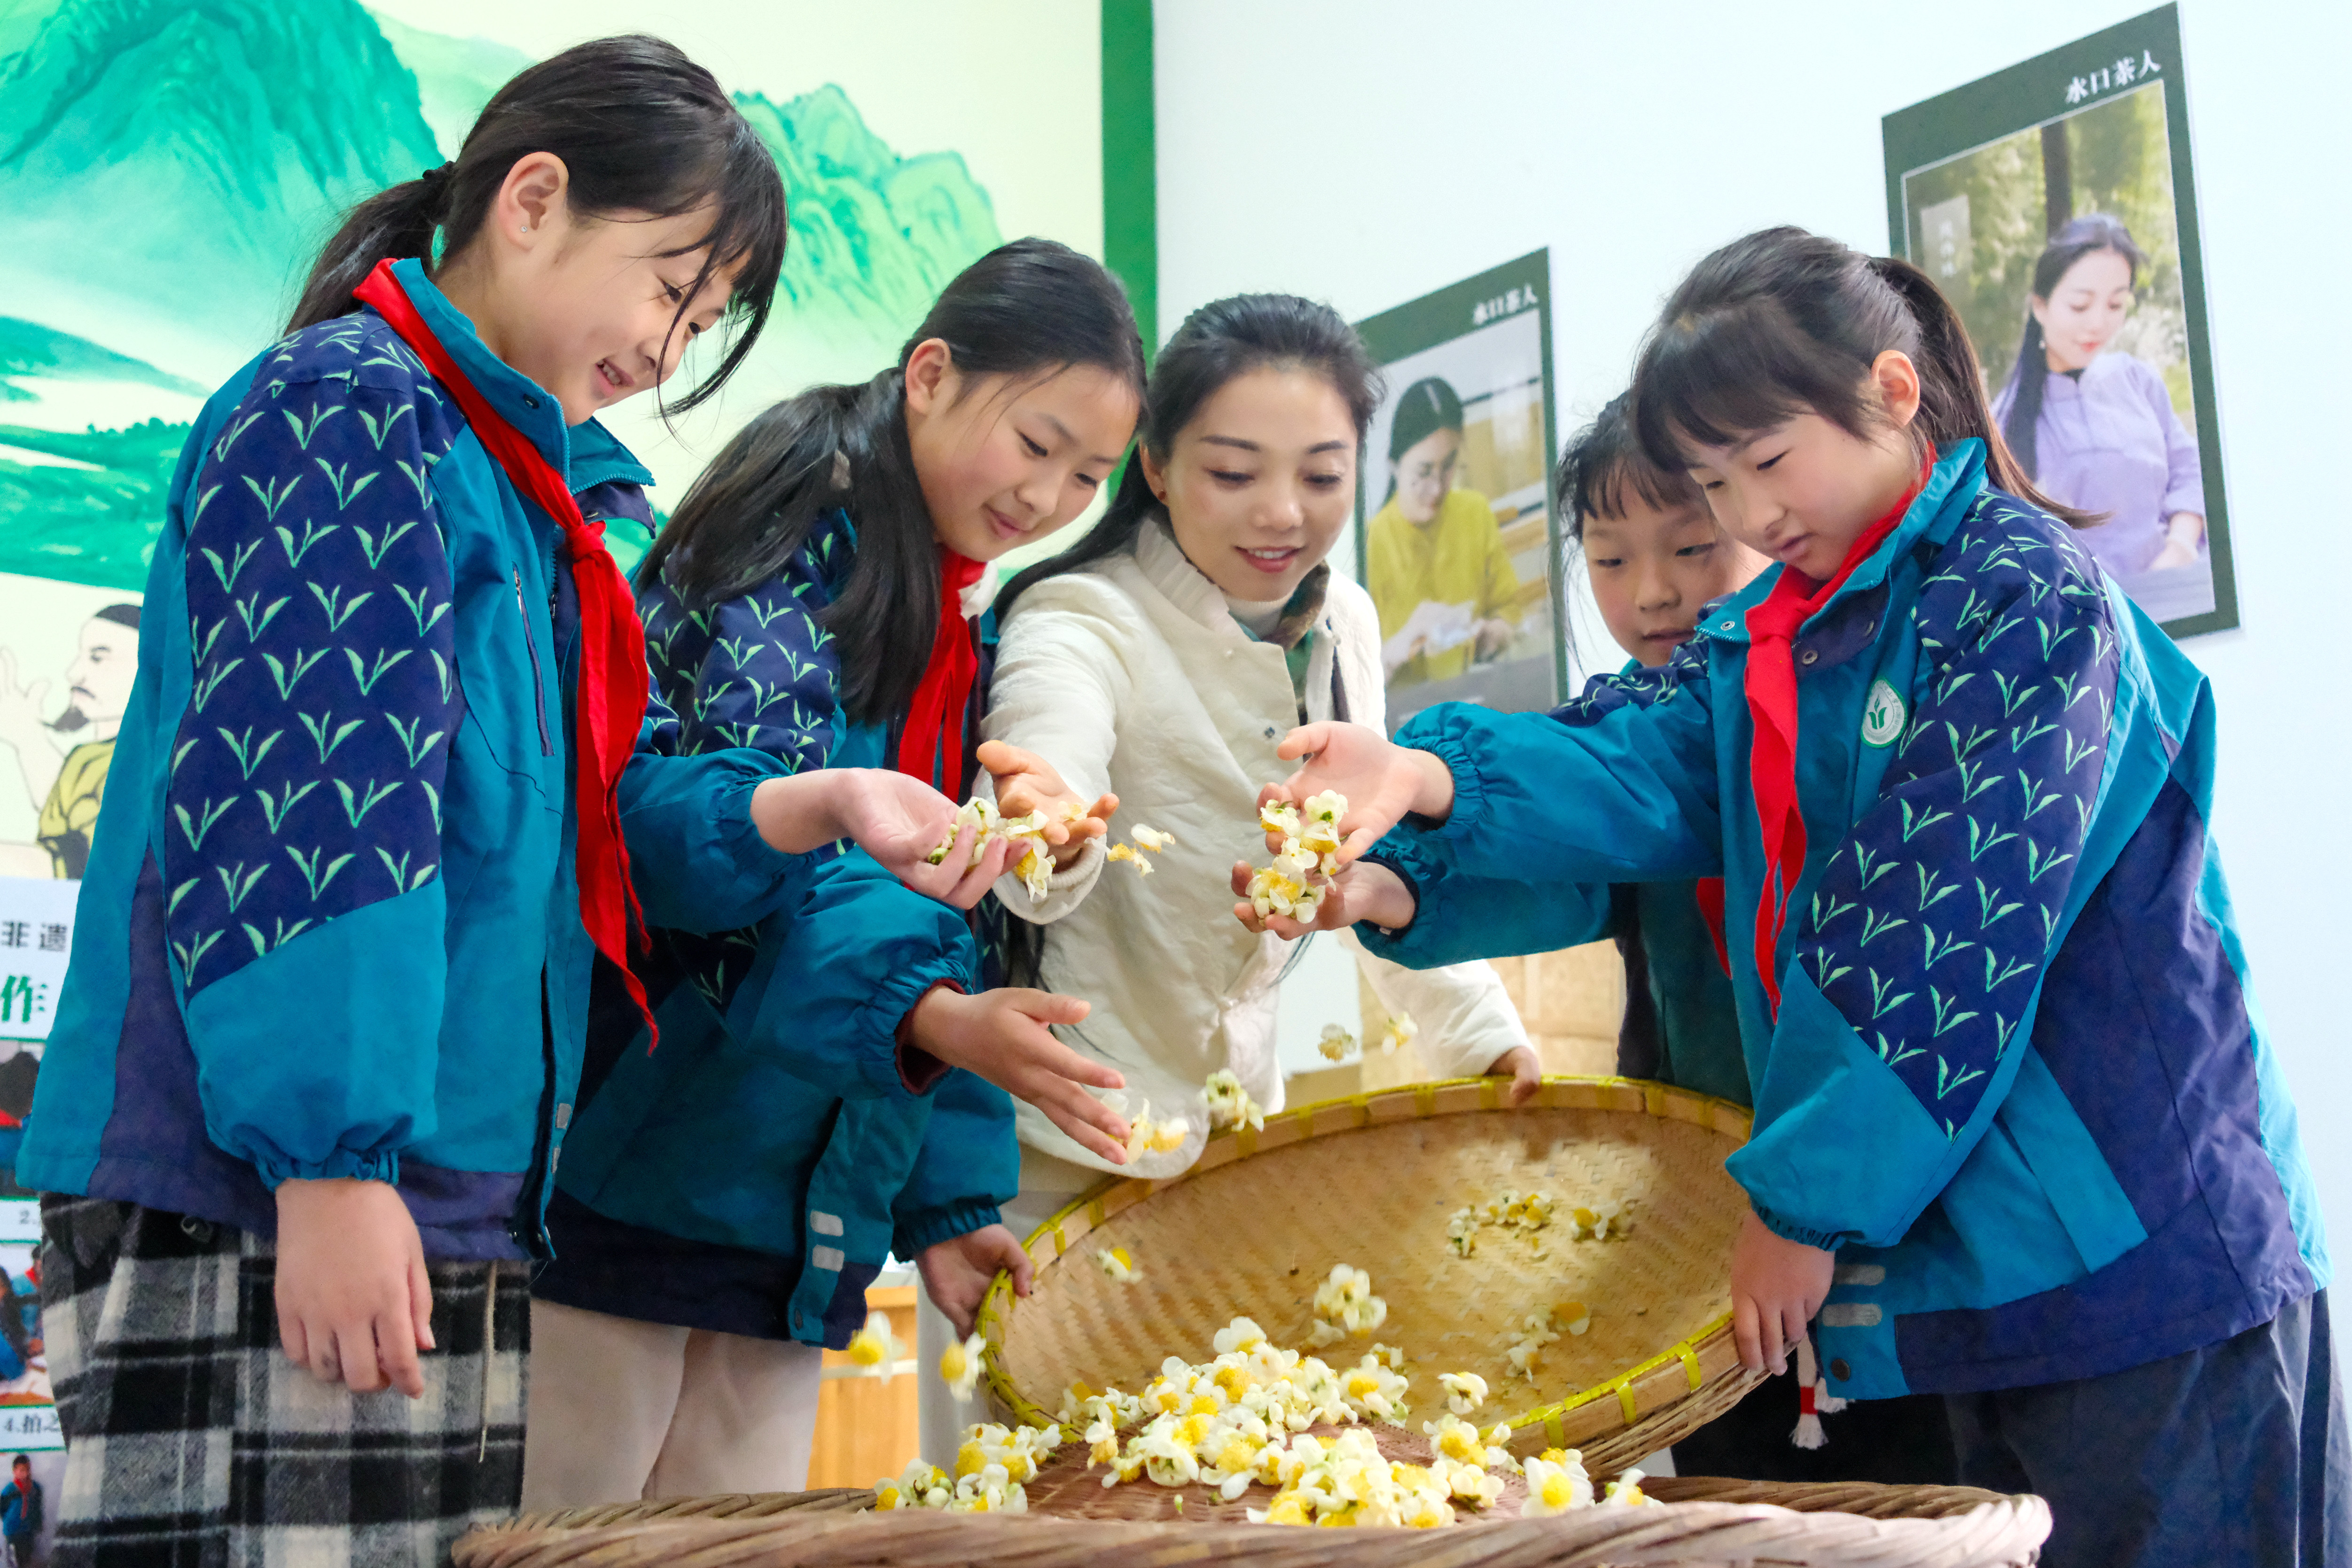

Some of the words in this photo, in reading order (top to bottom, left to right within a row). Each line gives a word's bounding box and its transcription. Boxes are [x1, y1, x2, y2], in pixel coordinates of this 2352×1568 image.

[2065, 49, 2161, 104] 水口茶人
[1, 920, 67, 952] 非遗
[0, 975, 48, 1022] 作
